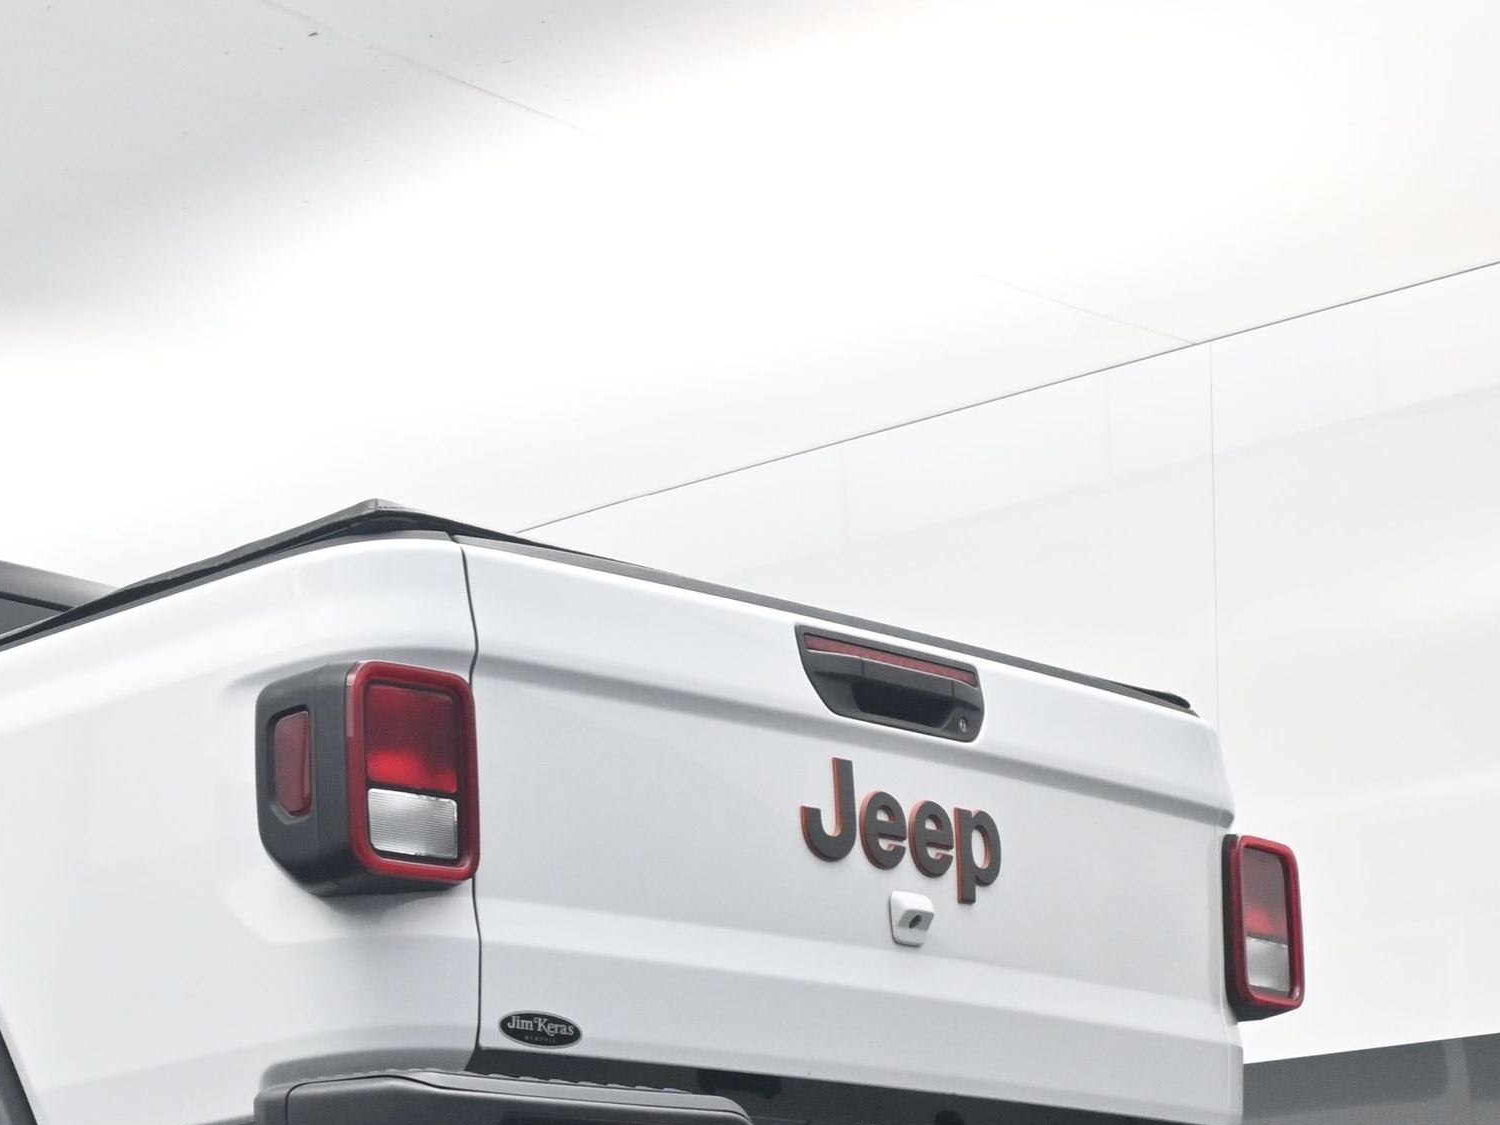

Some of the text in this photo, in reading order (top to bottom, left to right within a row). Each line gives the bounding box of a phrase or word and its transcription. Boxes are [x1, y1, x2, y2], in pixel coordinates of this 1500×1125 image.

[800, 757, 1001, 905] Jeep
[507, 1015, 574, 1037] Jim Keras
